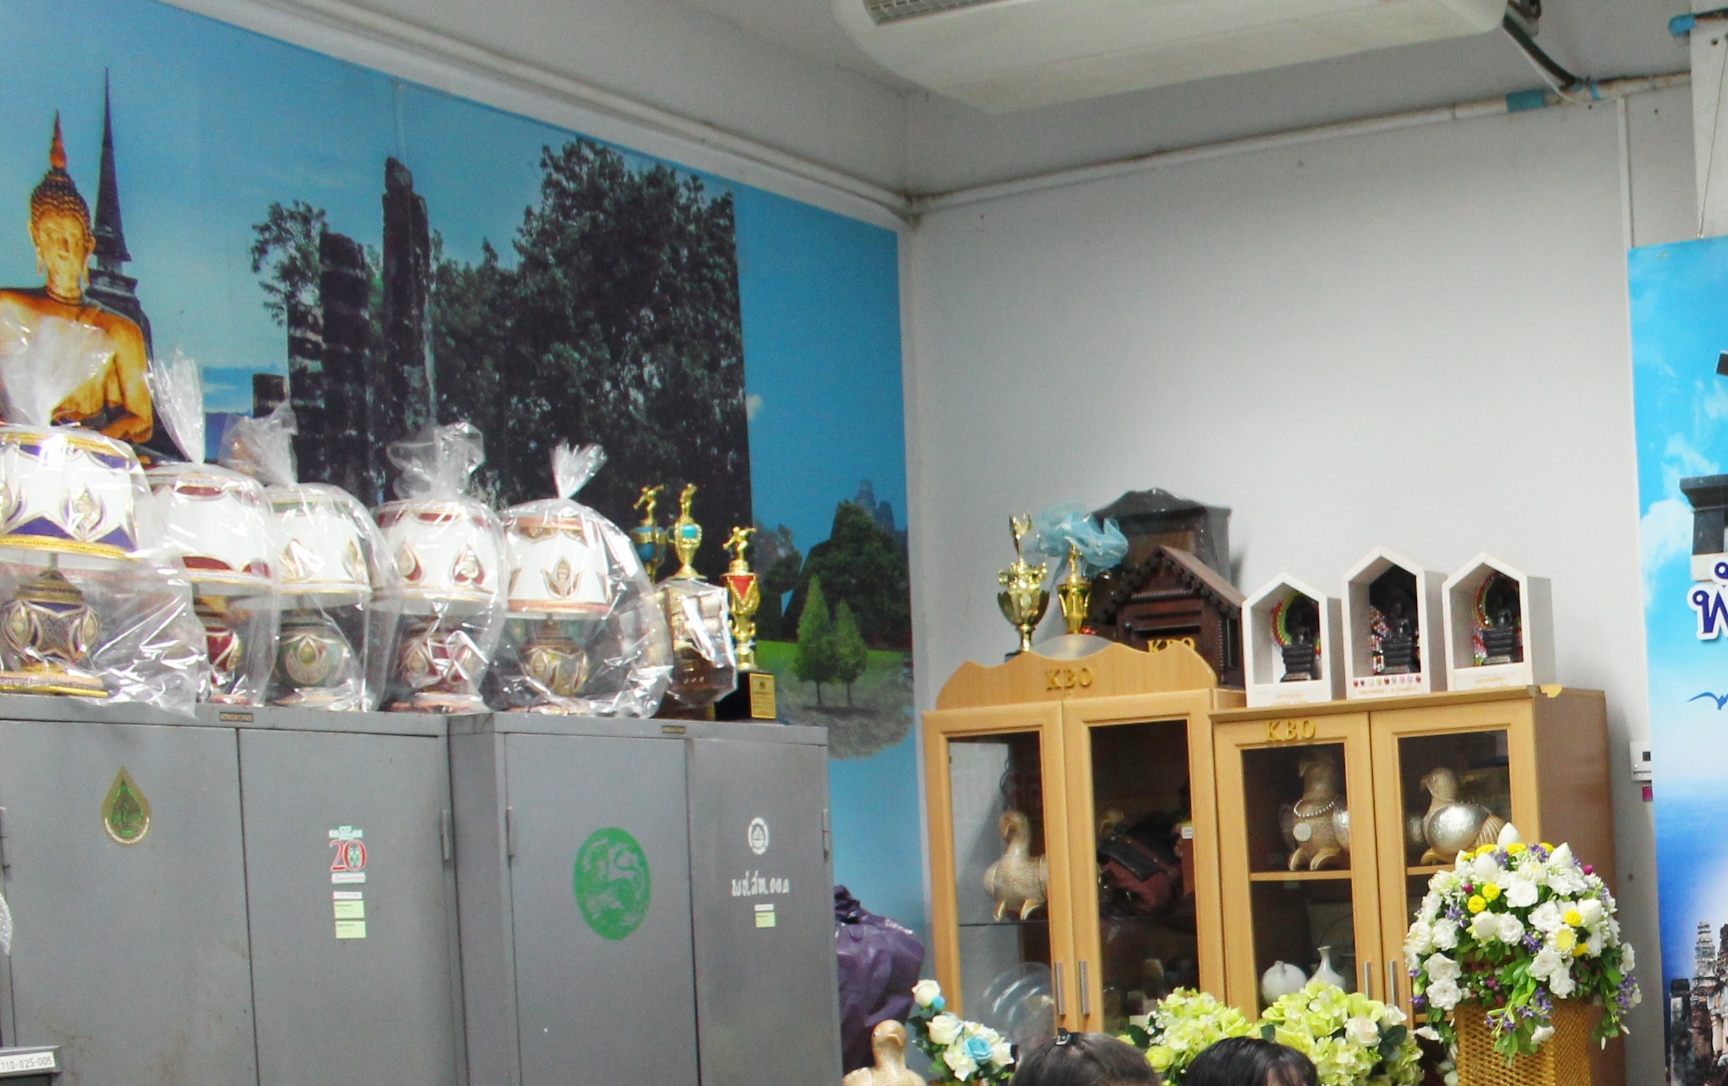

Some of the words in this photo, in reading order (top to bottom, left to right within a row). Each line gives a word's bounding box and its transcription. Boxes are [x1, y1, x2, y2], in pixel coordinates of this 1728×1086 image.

[1046, 667, 1094, 690] KBO
[1266, 719, 1316, 742] KBO
[329, 839, 367, 871] 20
